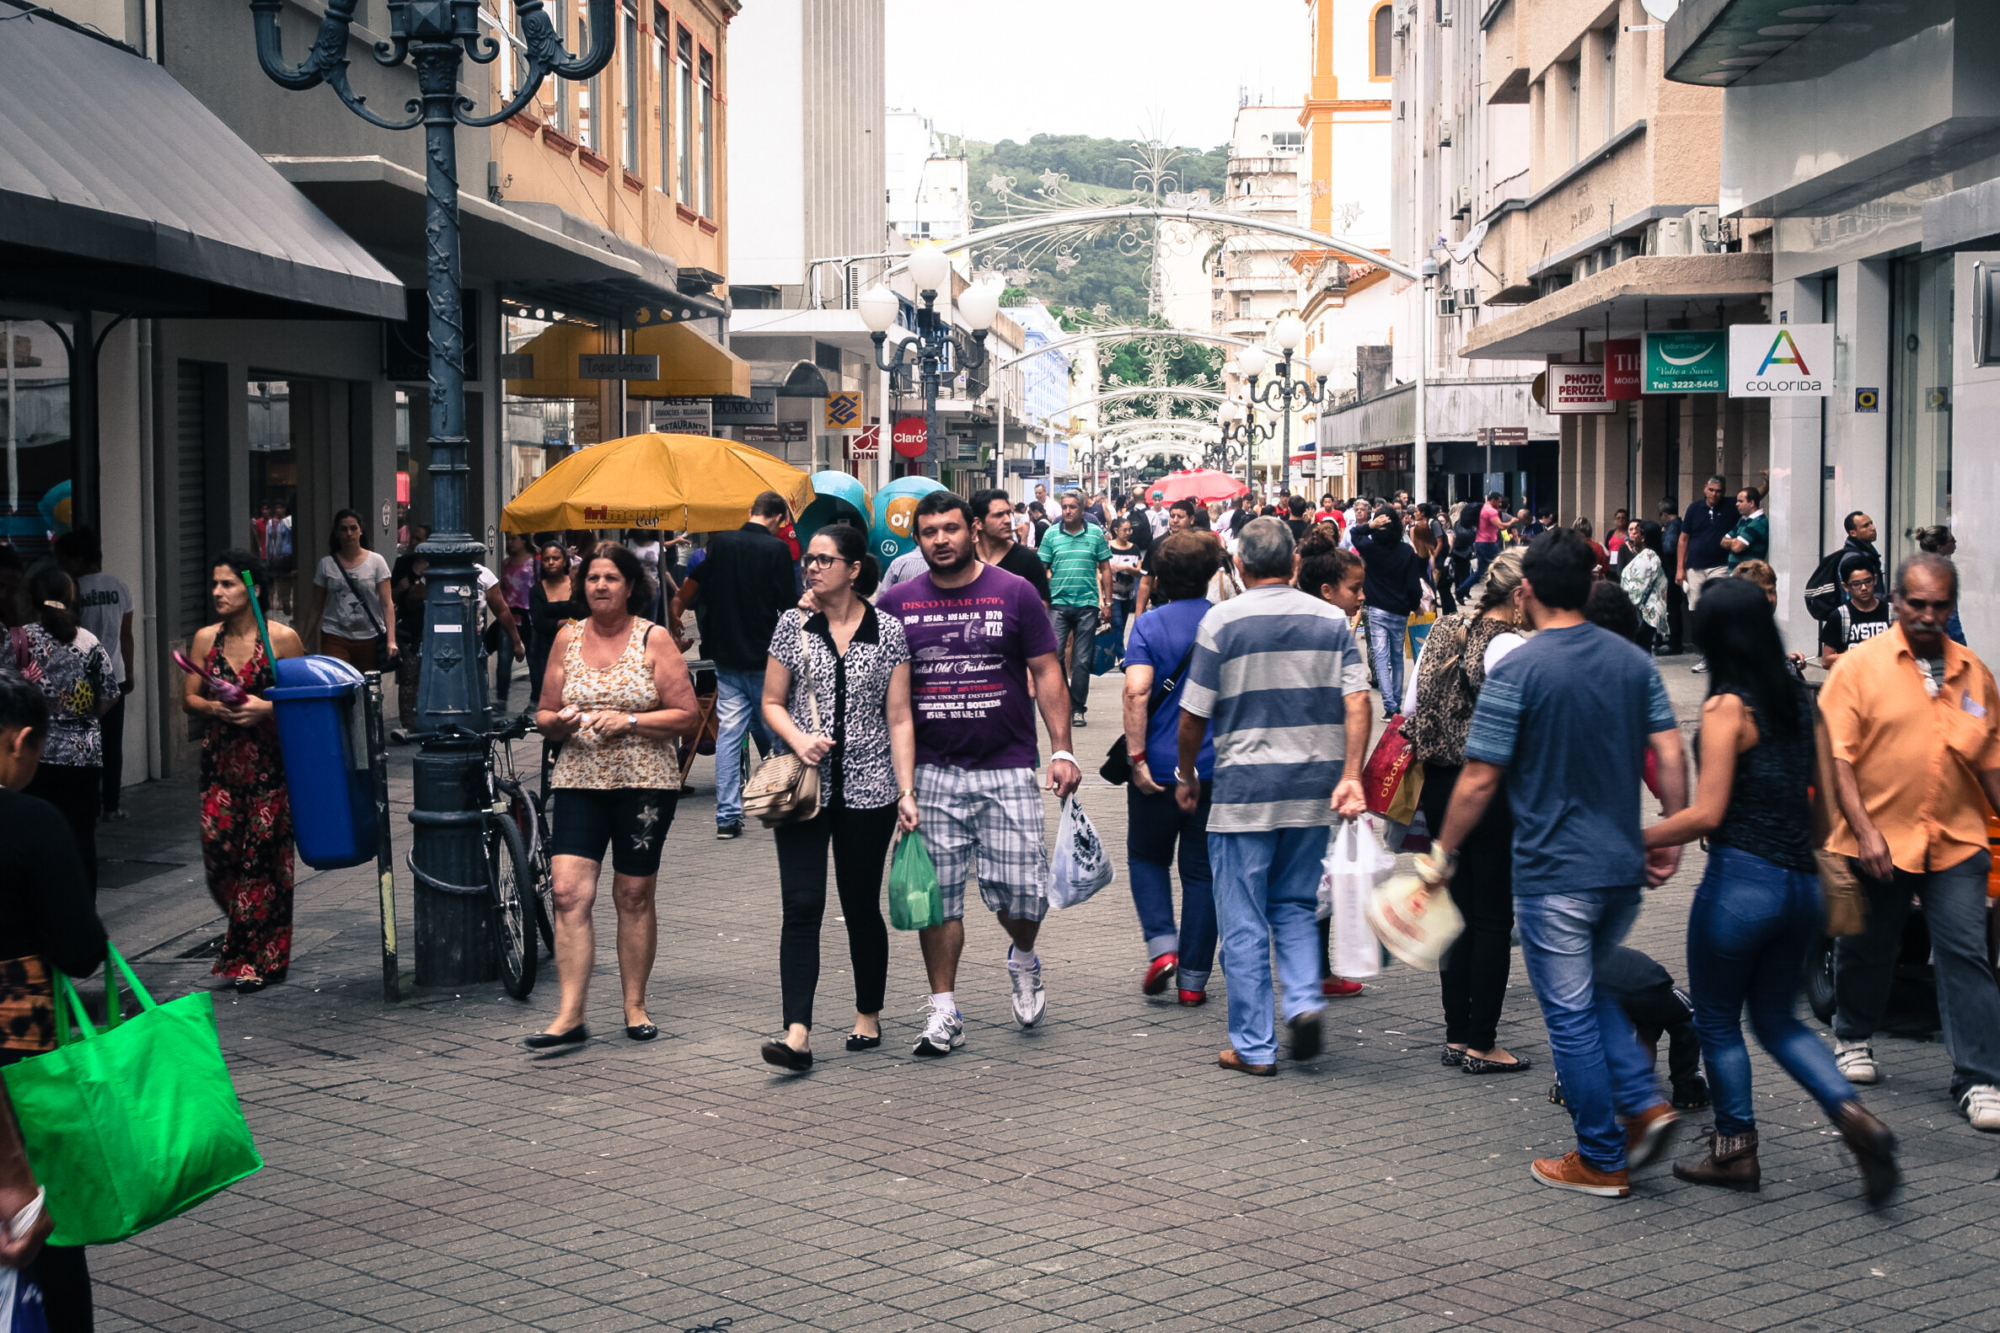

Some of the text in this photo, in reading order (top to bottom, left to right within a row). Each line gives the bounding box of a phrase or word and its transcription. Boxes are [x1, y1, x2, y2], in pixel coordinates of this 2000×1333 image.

[585, 358, 652, 375] Toque Urbano
[1656, 366, 1680, 375] Volte
[1564, 374, 1602, 384] PHOTO
[1652, 380, 1719, 389] Tel: 3222-5445
[893, 433, 924, 443] Claro
[853, 452, 878, 460] DINI
[891, 510, 911, 529] oi
[883, 543, 895, 553] 14
[901, 600, 939, 611] DISCO
[940, 598, 972, 608] YEAR
[985, 610, 1003, 620] 1970
[935, 661, 954, 674] Old
